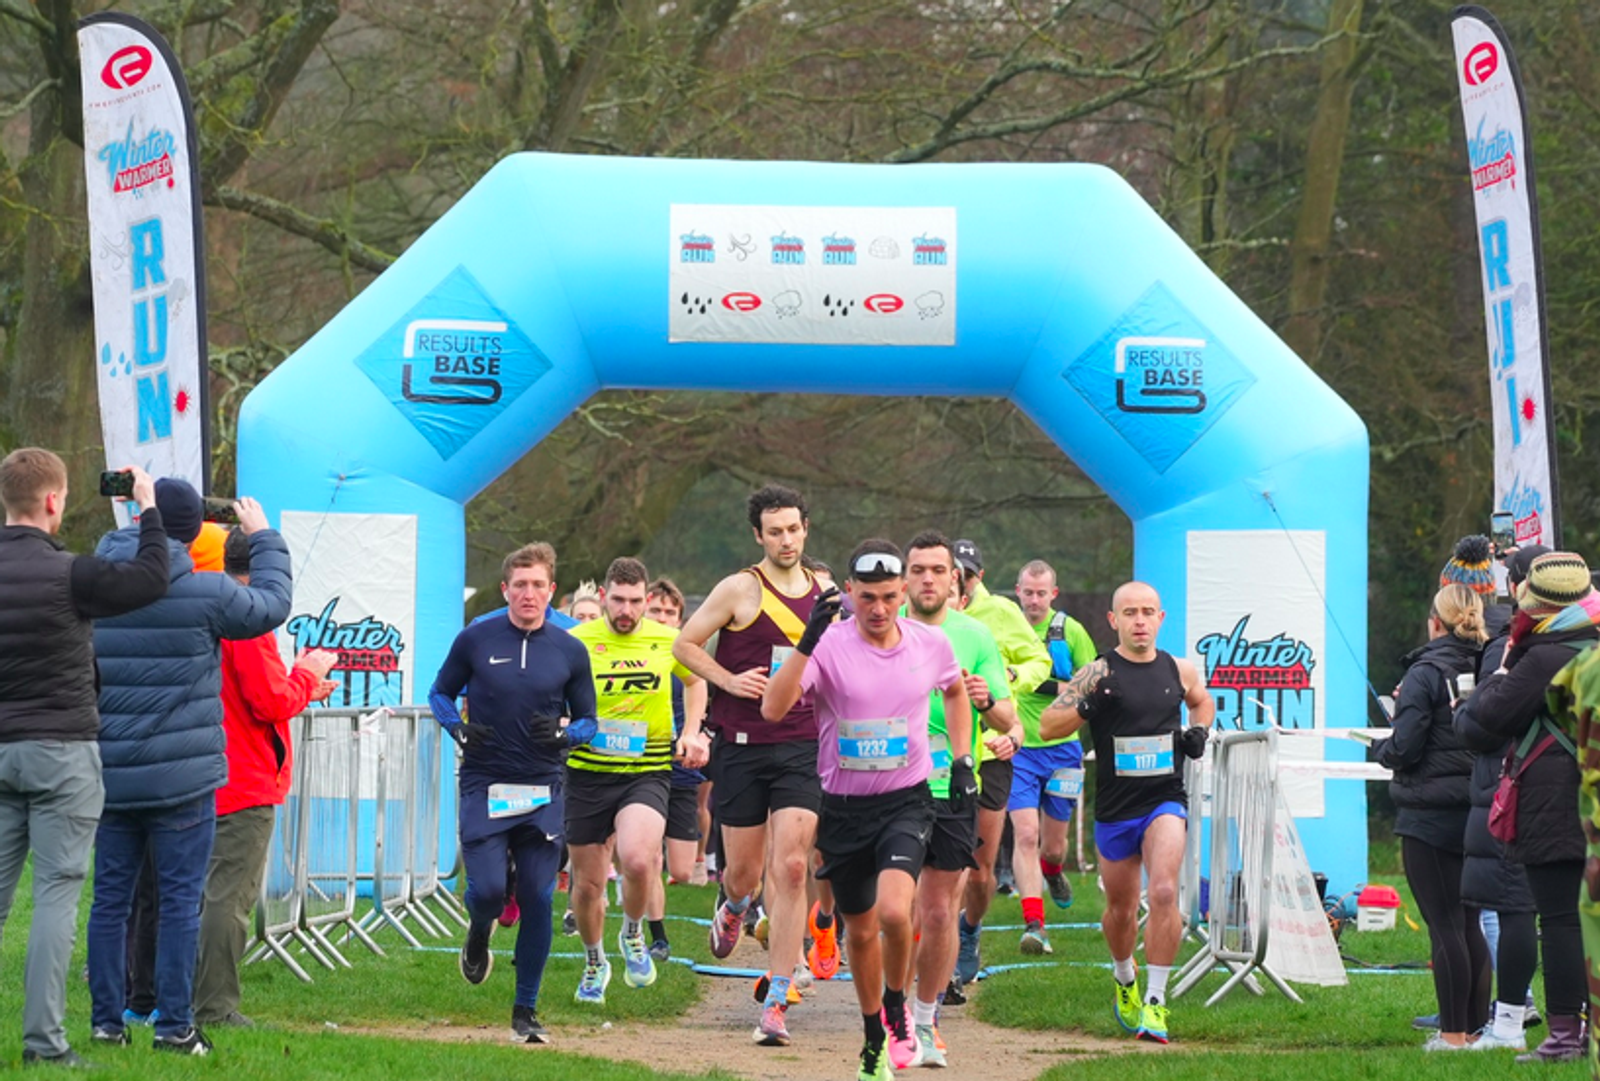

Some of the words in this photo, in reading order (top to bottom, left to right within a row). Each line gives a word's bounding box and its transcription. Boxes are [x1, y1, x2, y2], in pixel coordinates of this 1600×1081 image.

[98, 114, 176, 189] Winter
[117, 158, 172, 190] WARMER
[681, 249, 715, 263] RUN
[771, 251, 805, 265] RUN
[822, 250, 857, 265] RUN
[913, 250, 947, 265] RUN
[129, 216, 172, 444] RUN
[419, 334, 503, 355] RESULTS
[435, 355, 502, 376] BASE
[1129, 350, 1203, 368] RESULTS
[1145, 369, 1203, 386] BASE
[287, 596, 405, 659] Winter
[1195, 612, 1316, 685] Winter
[337, 651, 393, 668] RMER
[596, 671, 662, 692] TRI
[1216, 670, 1304, 685] WARMER
[308, 669, 403, 708] UN
[1206, 687, 1315, 732] RUN
[856, 739, 888, 757] 1232
[1134, 753, 1157, 769] 1177
